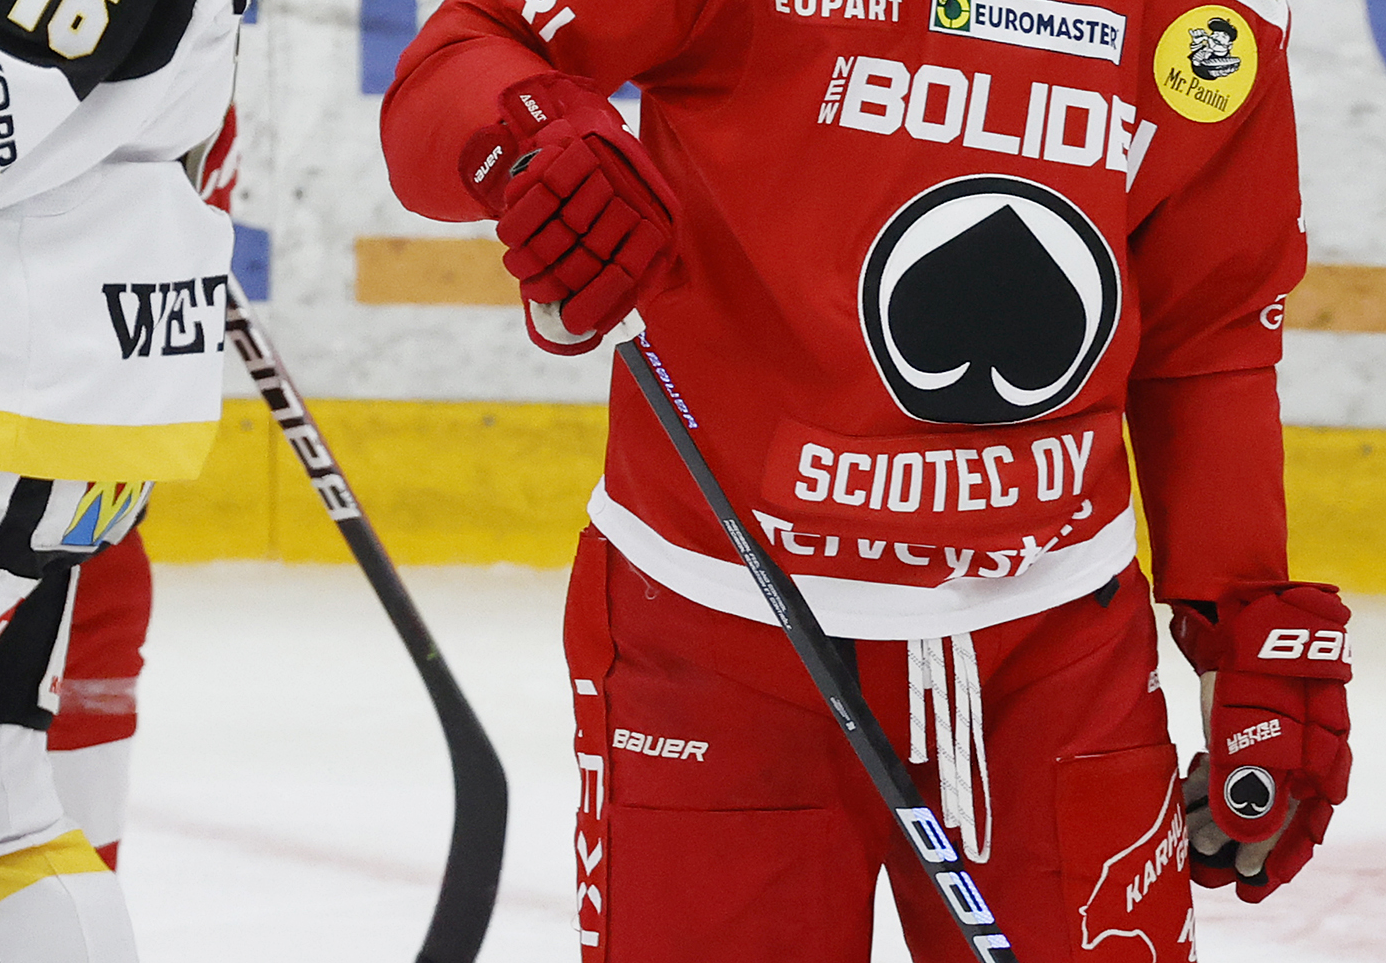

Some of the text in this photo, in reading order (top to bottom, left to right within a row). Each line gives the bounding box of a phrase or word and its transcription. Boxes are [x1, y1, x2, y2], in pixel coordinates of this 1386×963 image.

[974, 3, 1118, 50] EUROMASTER
[817, 55, 855, 125] NEW
[1164, 67, 1231, 113] Mr. Panini
[794, 430, 1096, 513] SCIOTEC OY
[612, 727, 710, 763] BAUER
